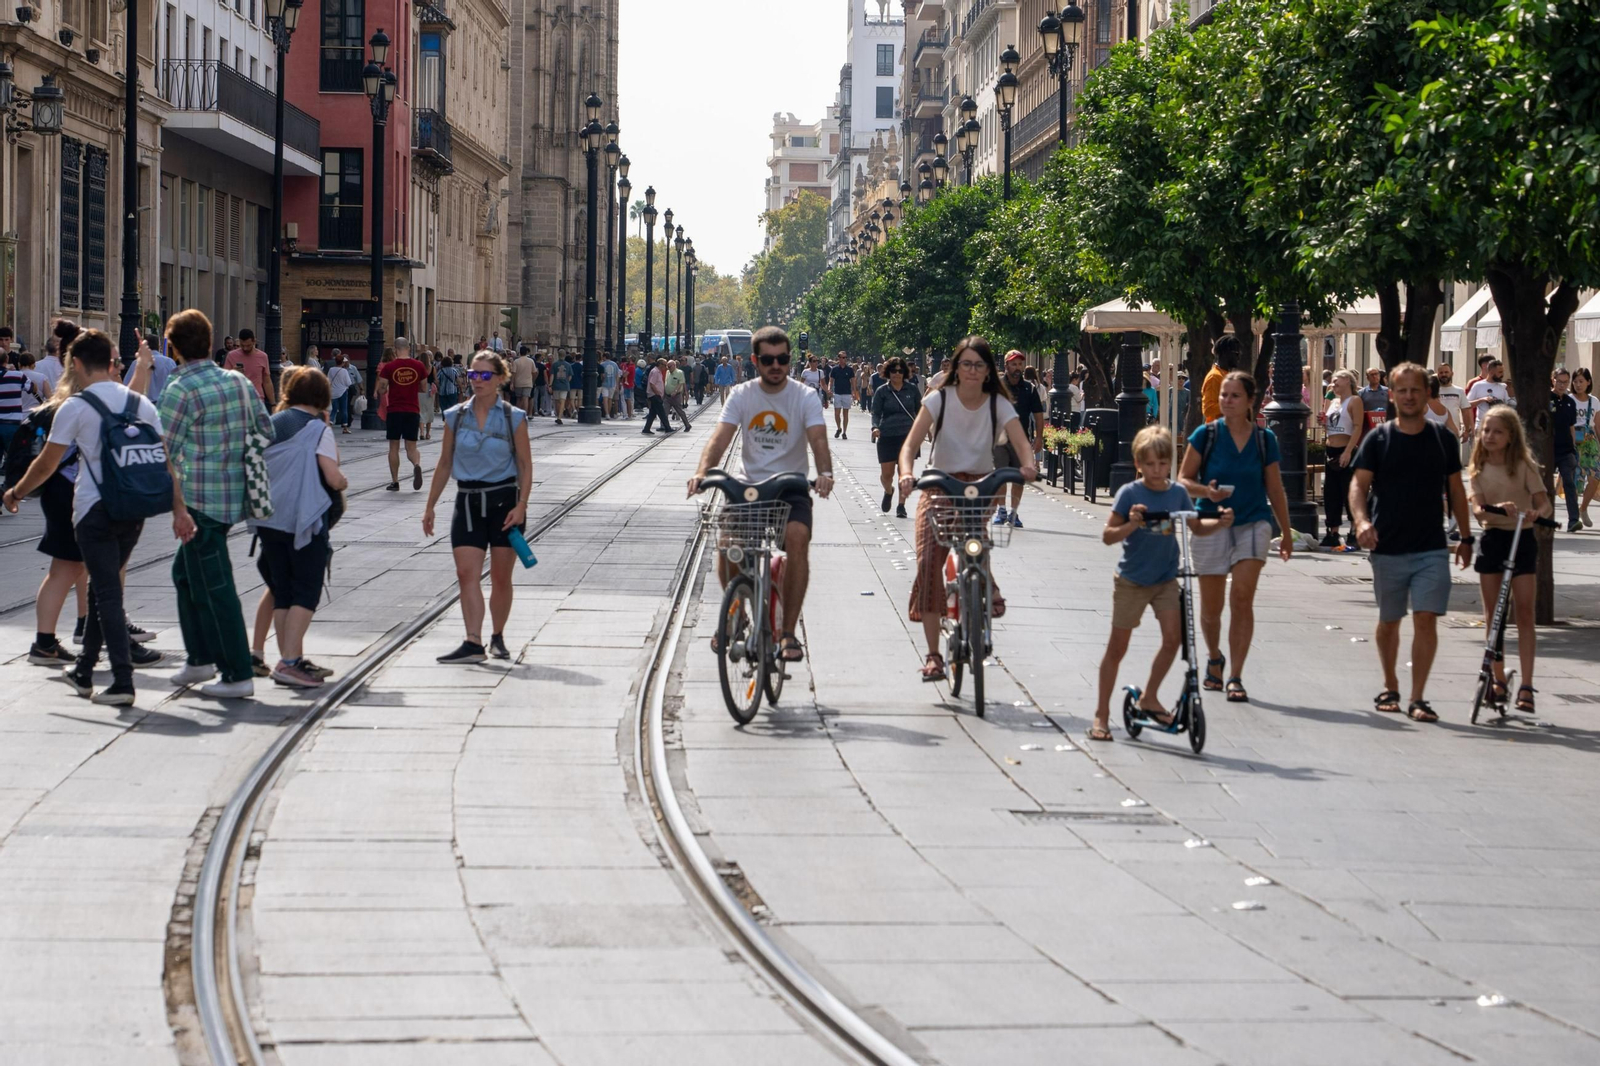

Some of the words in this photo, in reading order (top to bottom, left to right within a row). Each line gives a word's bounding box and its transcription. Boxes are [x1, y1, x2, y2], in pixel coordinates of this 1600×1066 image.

[869, 25, 898, 36] AXA
[754, 436, 782, 445] ELEMENT
[110, 441, 167, 468] VANS
[1492, 580, 1509, 631] HUDORA
